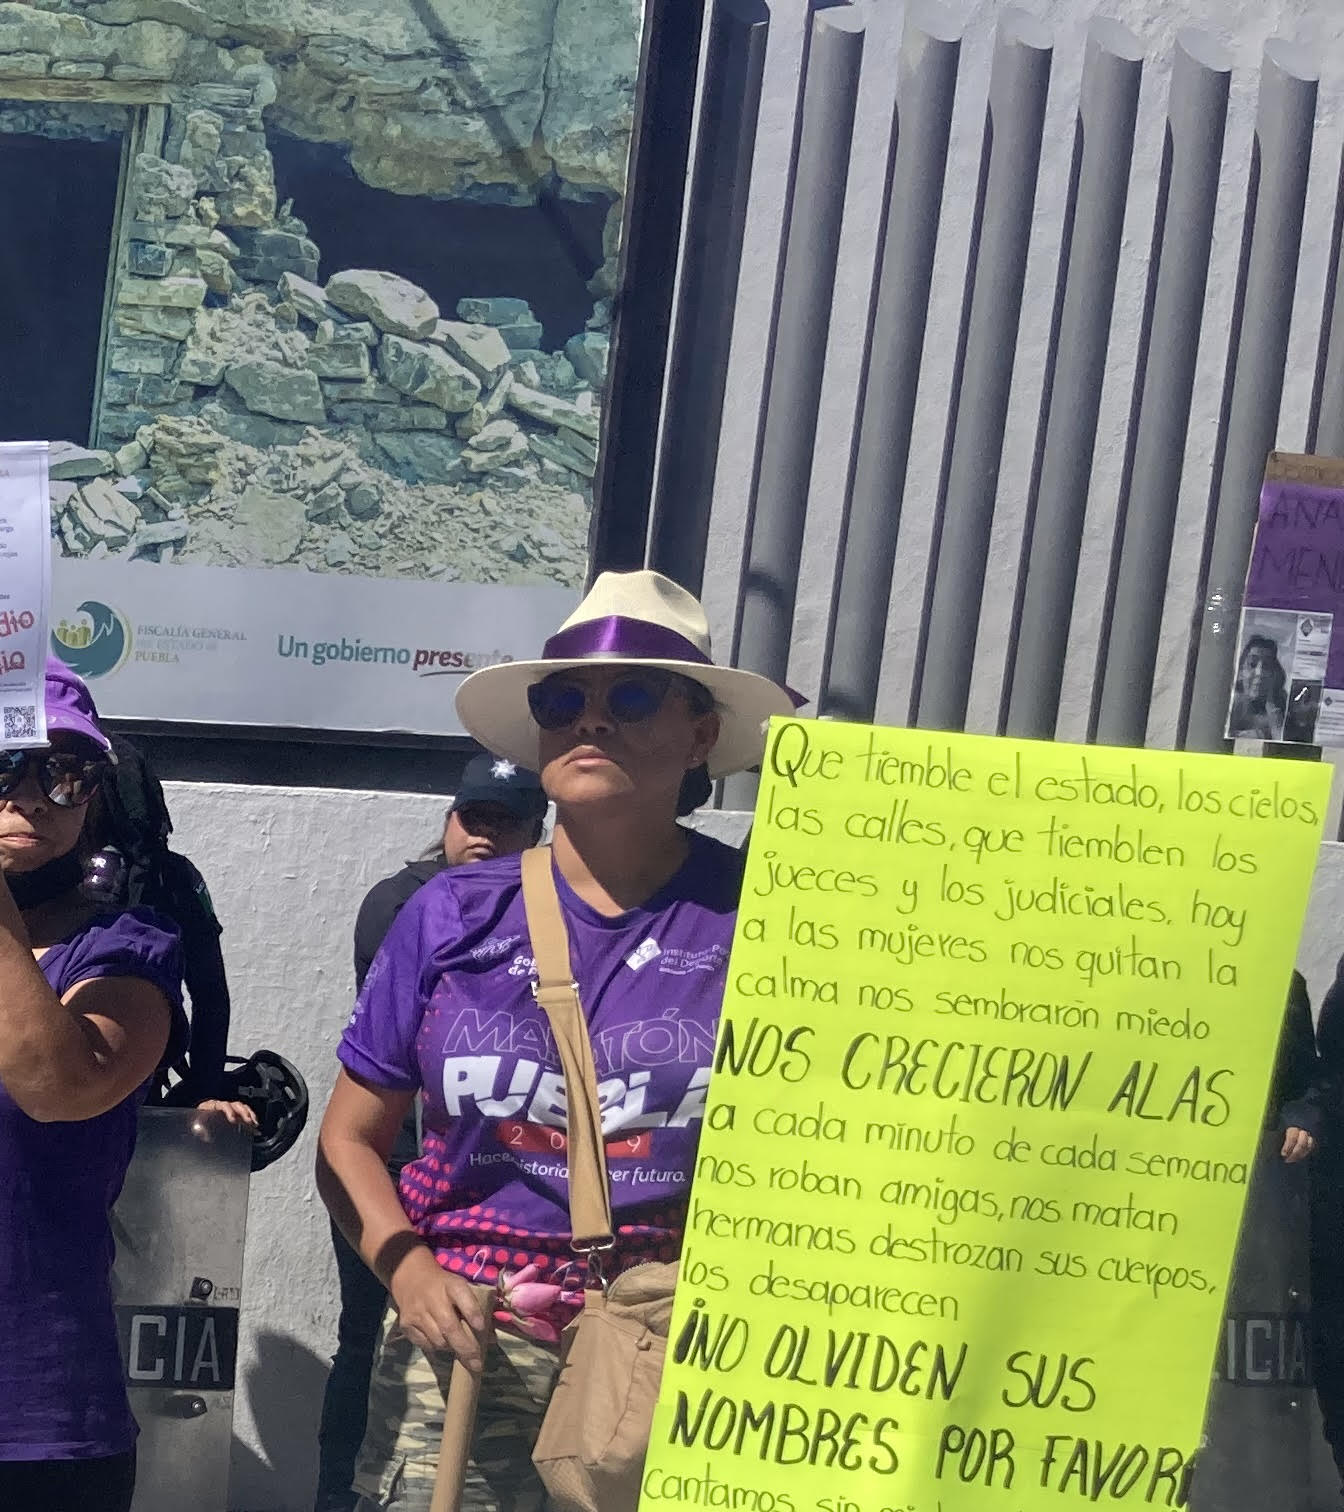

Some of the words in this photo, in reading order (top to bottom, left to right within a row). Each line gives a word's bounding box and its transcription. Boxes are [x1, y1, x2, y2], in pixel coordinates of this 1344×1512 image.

[192, 628, 247, 641] GENERAL
[278, 635, 309, 658] Un
[313, 638, 410, 666] gobierno
[858, 733, 972, 791] tiemble
[754, 850, 878, 896] jueces
[1040, 816, 1185, 868] tiemblen
[860, 924, 987, 964] mujeres
[1077, 936, 1181, 987] quitan
[841, 1031, 1092, 1111] CRECIERON
[865, 1115, 974, 1156] minuto
[1127, 1152, 1247, 1185] semana
[690, 1199, 855, 1254] hermanas
[870, 1223, 1023, 1272] destrozan
[750, 1260, 959, 1321] desaparecen
[764, 1325, 968, 1401] OLVIDEN
[668, 1389, 900, 1475] NOMBRES
